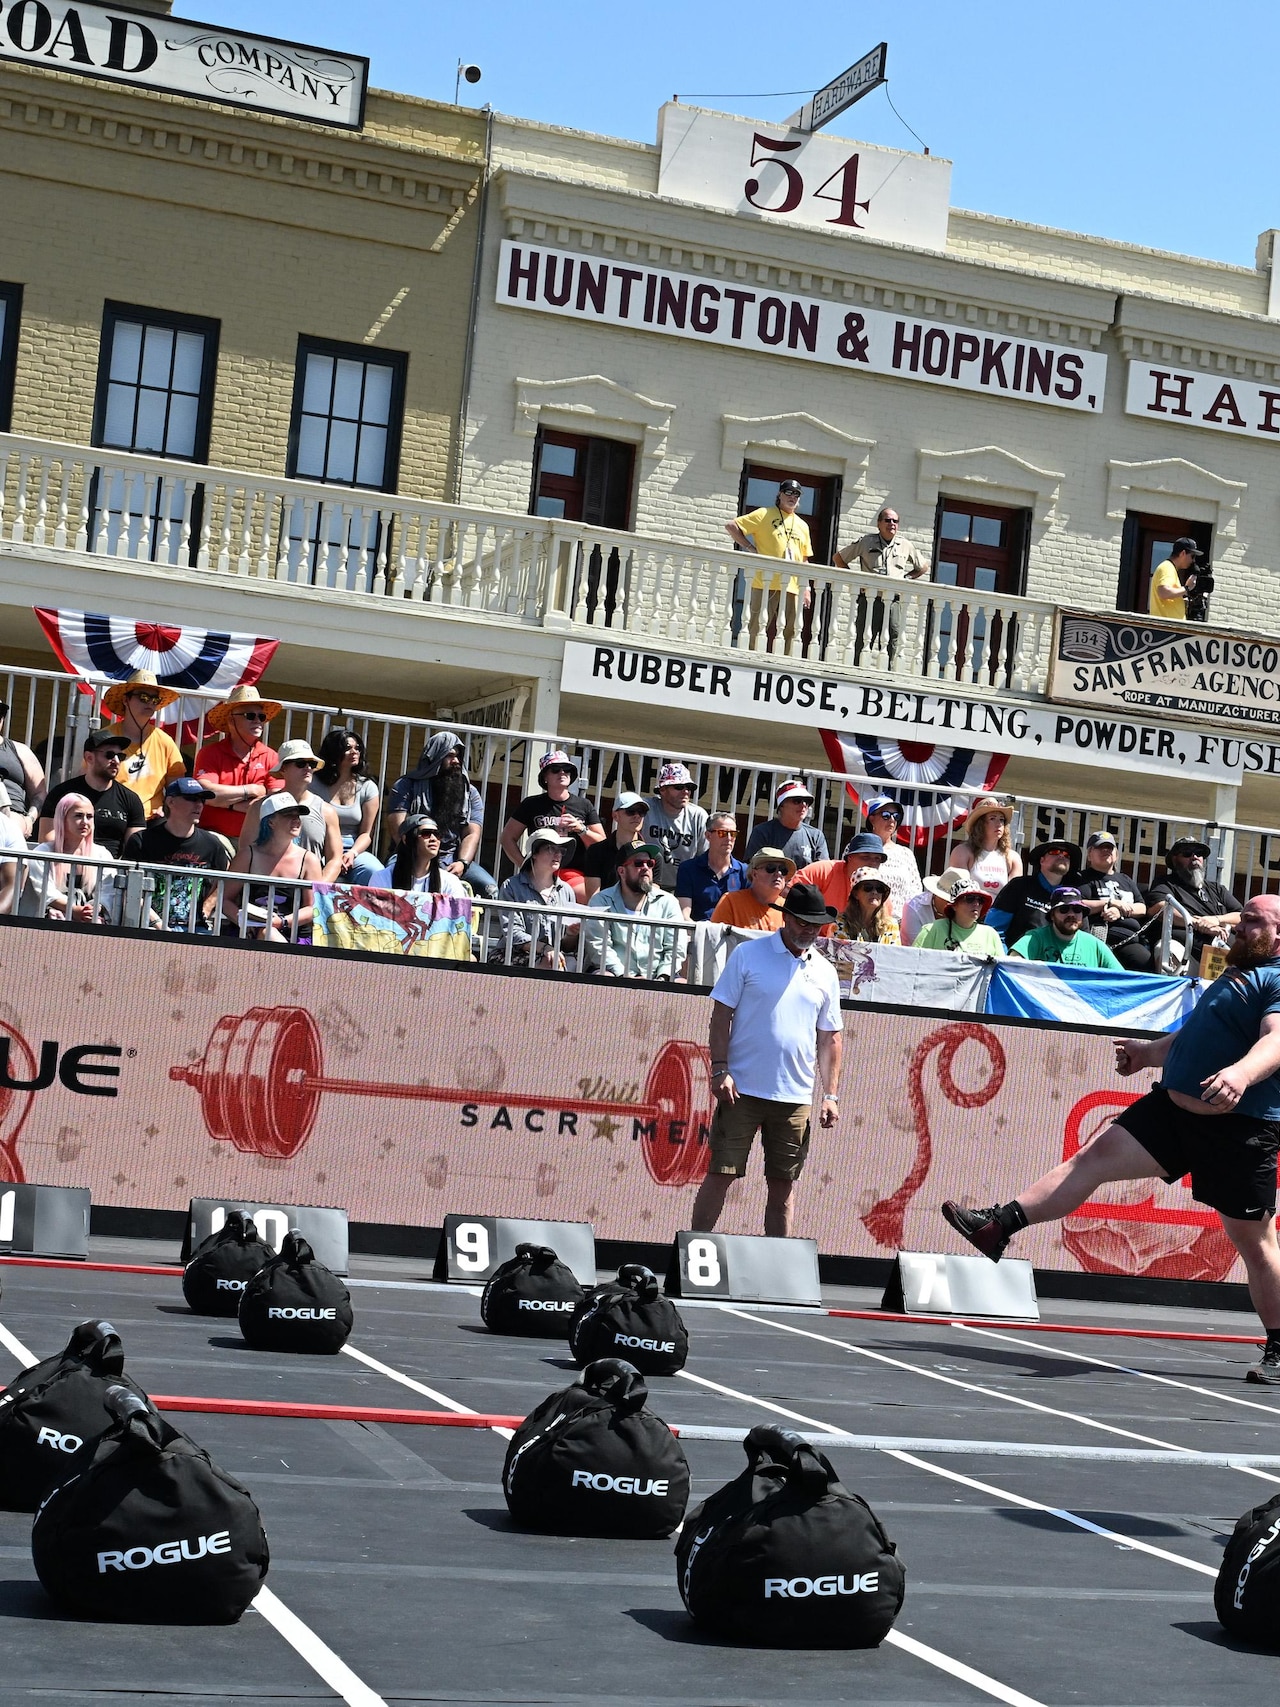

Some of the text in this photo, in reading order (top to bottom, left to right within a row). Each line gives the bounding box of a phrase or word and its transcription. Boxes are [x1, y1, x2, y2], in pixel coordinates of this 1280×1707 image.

[0, 0, 348, 107] OAD COMPANY
[814, 53, 880, 120] HARDWARE
[744, 131, 871, 229] 54
[506, 247, 1097, 410] HUNTINGTON & HOPKINS,
[1074, 630, 1099, 646] 154
[1073, 662, 1127, 692] SAN
[1131, 638, 1278, 684] FRANCISCO
[592, 647, 731, 698] RUBBER
[753, 672, 850, 720] HOSE,
[857, 686, 1042, 746] BELTING,
[1055, 715, 1186, 765] POWDER,
[1124, 690, 1151, 703] ROPE
[1156, 695, 1173, 706] AT
[577, 1075, 640, 1103] Visit
[455, 1222, 490, 1272] 9
[687, 1238, 721, 1287] 8
[910, 1258, 939, 1304] 7
[268, 1307, 337, 1320] ROGUE
[518, 1298, 576, 1312] ROGUE
[614, 1332, 676, 1354] ROGUE
[572, 1468, 670, 1497] ROGUE
[96, 1530, 232, 1574] ROGUE
[764, 1571, 880, 1600] ROGUE
